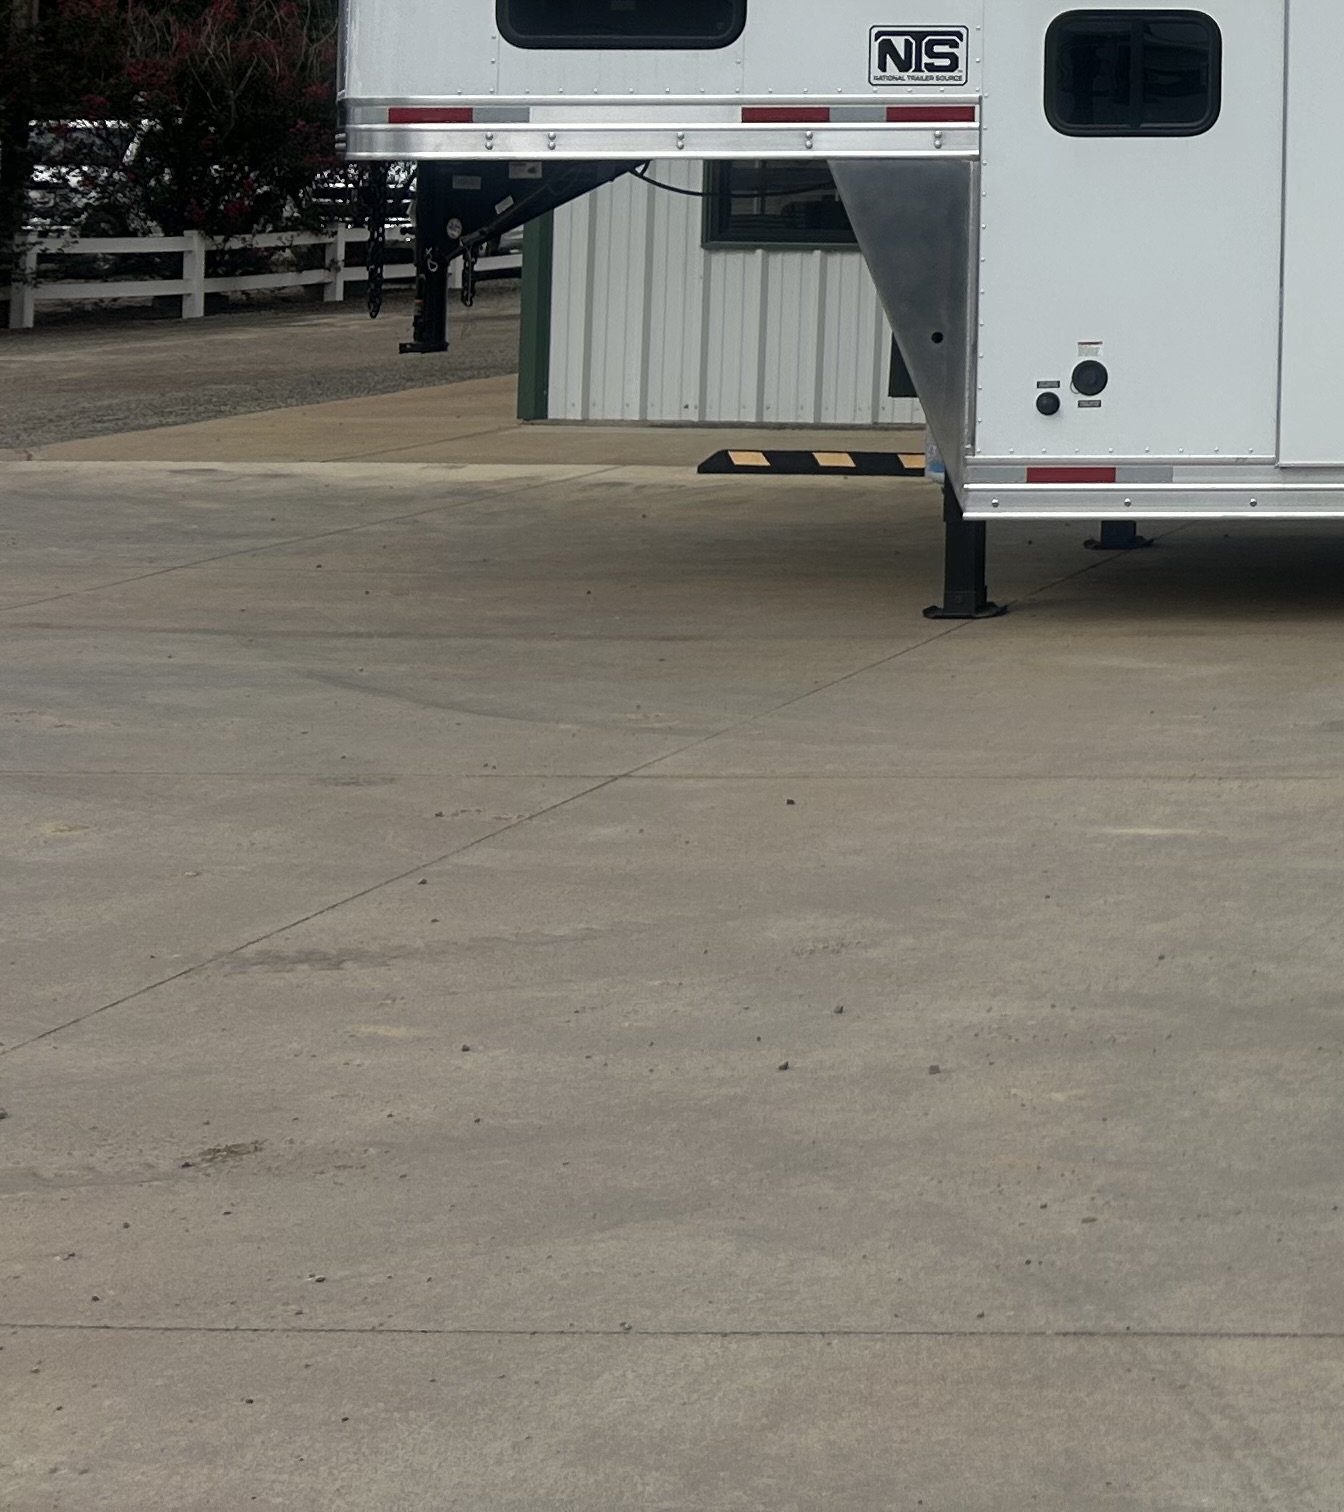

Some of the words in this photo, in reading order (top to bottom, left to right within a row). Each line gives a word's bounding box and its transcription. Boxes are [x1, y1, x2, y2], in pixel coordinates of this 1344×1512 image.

[874, 30, 964, 73] NTS
[873, 74, 906, 82] NATIONAL
[907, 74, 934, 82] TRAILER
[935, 74, 963, 82] SOURCE
